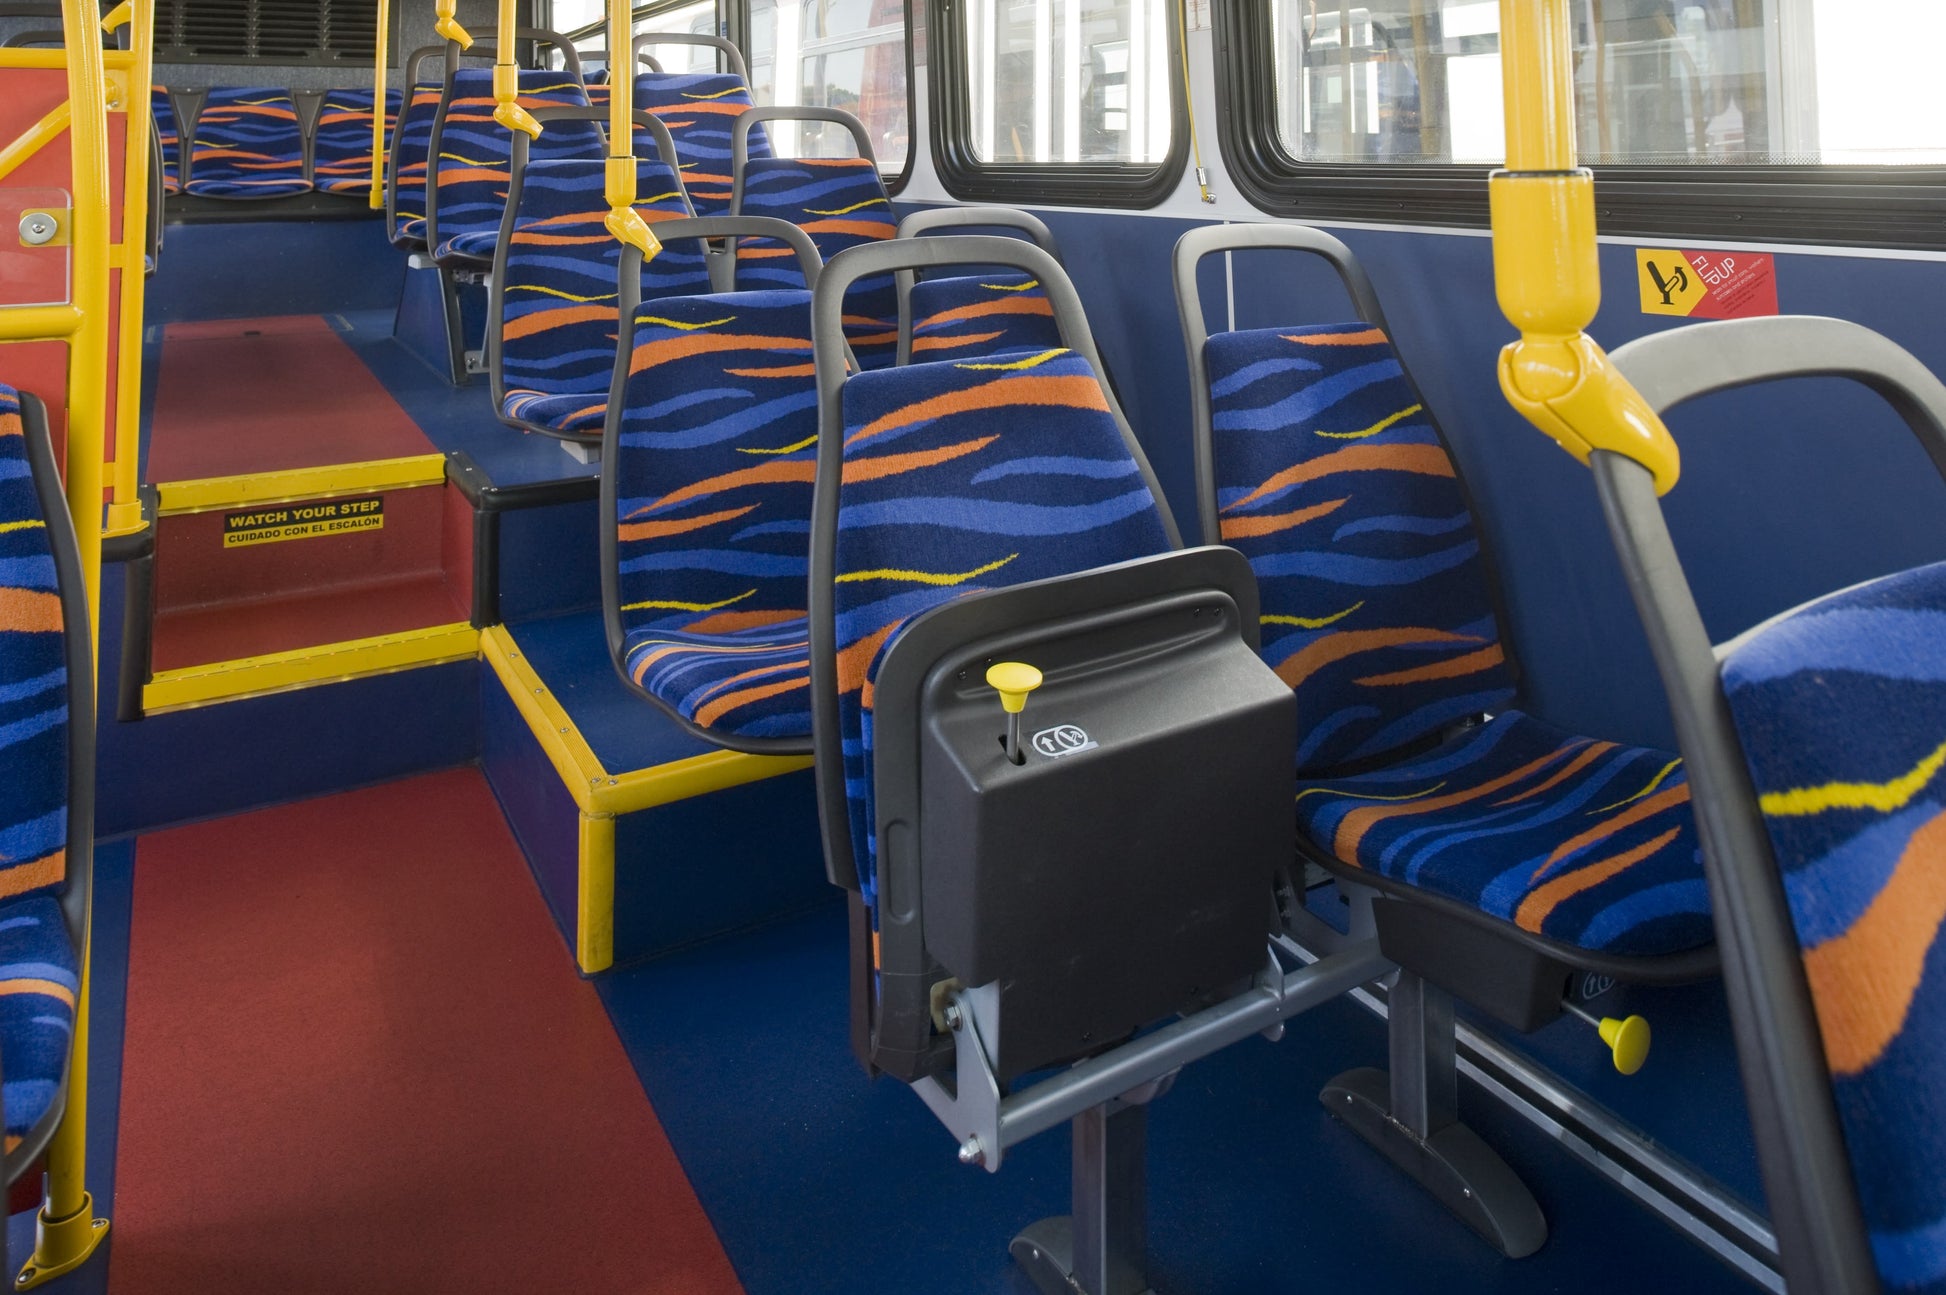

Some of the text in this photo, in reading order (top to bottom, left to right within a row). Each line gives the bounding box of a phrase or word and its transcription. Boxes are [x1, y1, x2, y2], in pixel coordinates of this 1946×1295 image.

[1692, 256, 1720, 284] FLIP
[1714, 258, 1735, 279] UP
[229, 501, 380, 528] WATCH YOUR STEP
[228, 517, 380, 543] CUIDADO CON EL ESCALÓN
